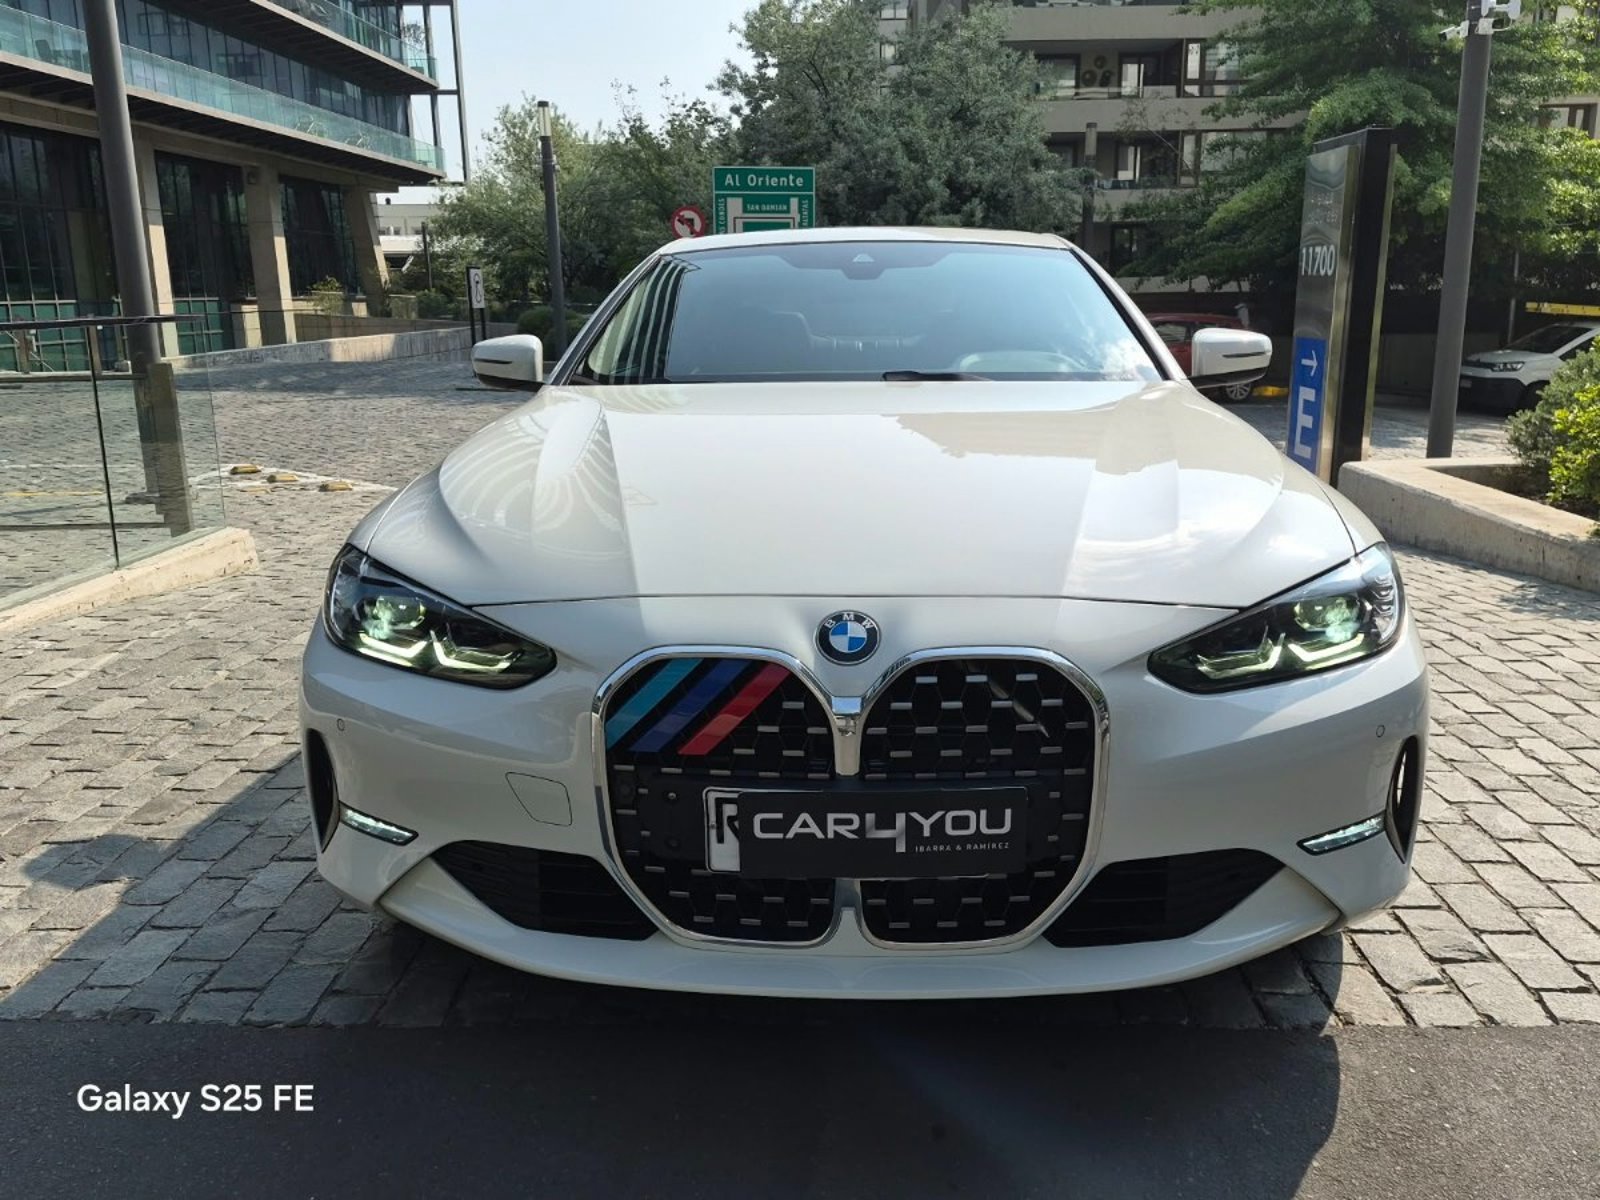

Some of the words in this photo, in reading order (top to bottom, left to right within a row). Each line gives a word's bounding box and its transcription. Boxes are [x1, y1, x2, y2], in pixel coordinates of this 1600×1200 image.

[725, 174, 740, 186] Al
[747, 174, 804, 186] Oriente
[718, 198, 726, 225] CONDES
[1301, 244, 1335, 276] 11700
[1294, 386, 1316, 459] E
[824, 612, 875, 629] BMW
[915, 844, 952, 853] IBARRA
